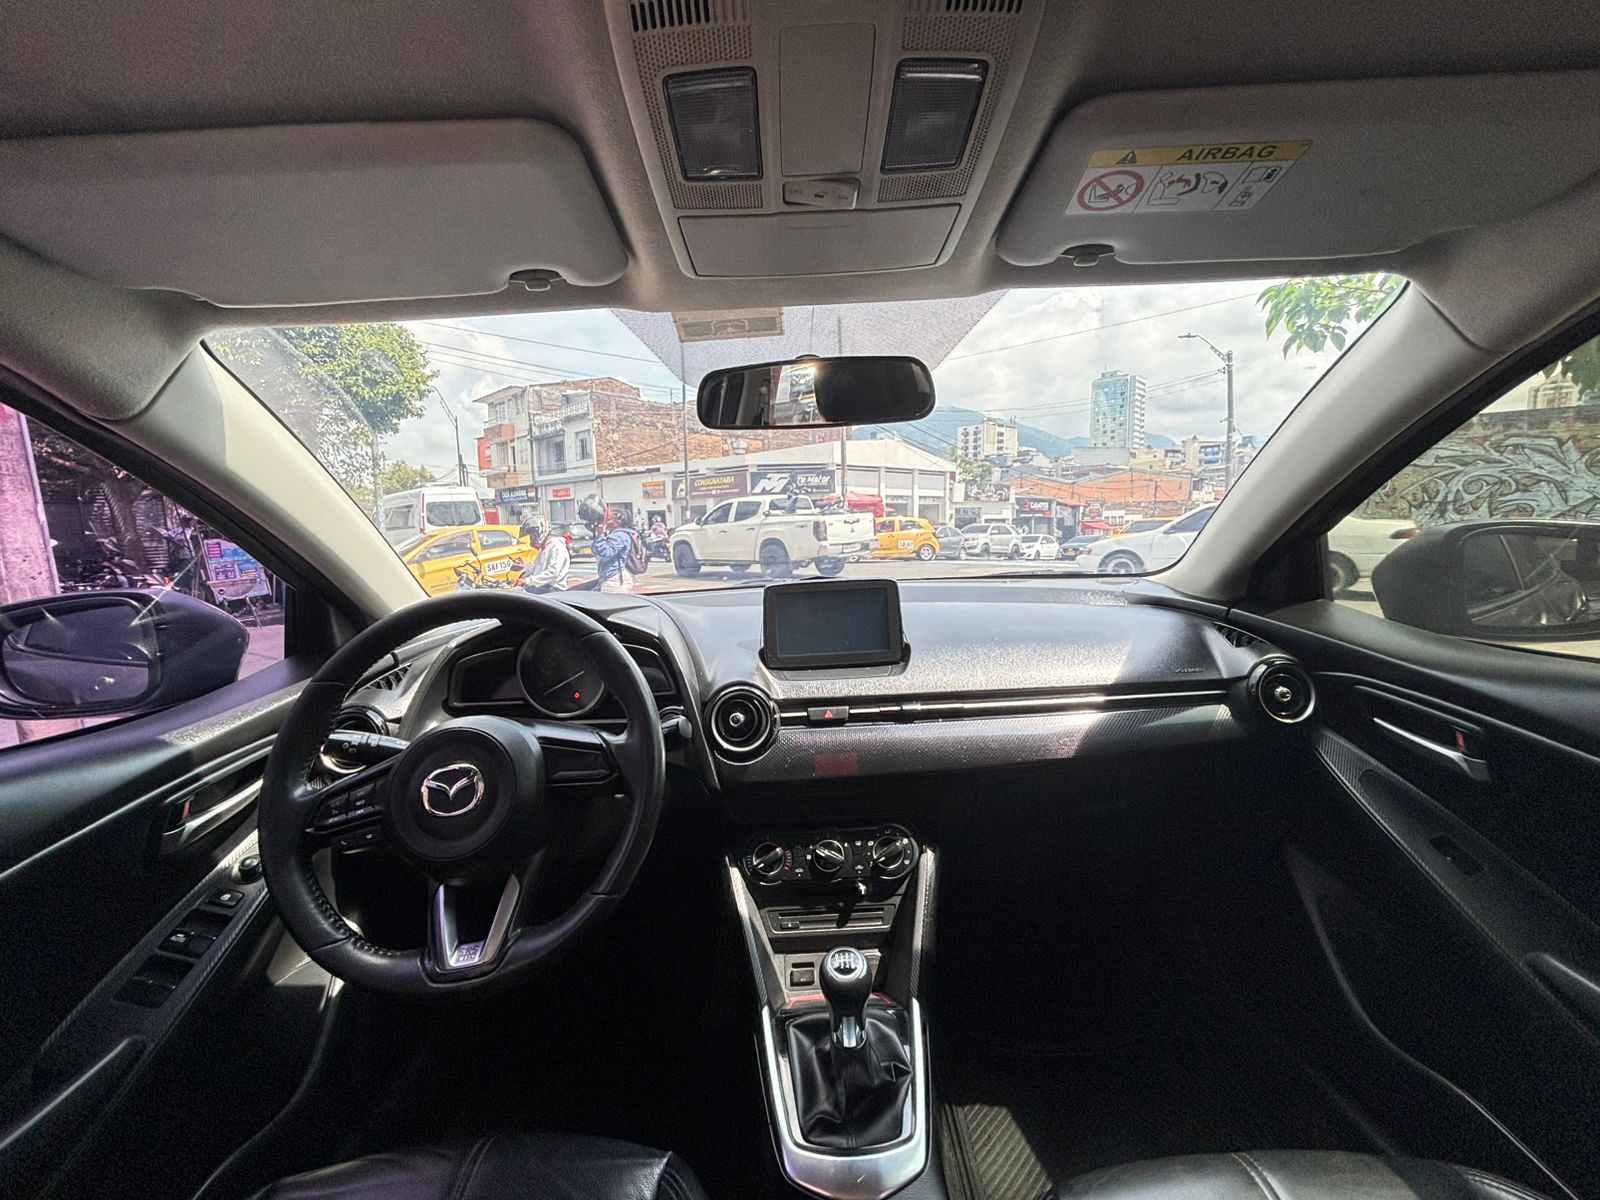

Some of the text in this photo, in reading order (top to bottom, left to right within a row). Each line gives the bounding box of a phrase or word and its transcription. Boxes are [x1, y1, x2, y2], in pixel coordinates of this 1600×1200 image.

[1176, 145, 1277, 162] AIRBAG
[807, 475, 830, 483] Motor
[487, 560, 511, 572] SXF150
